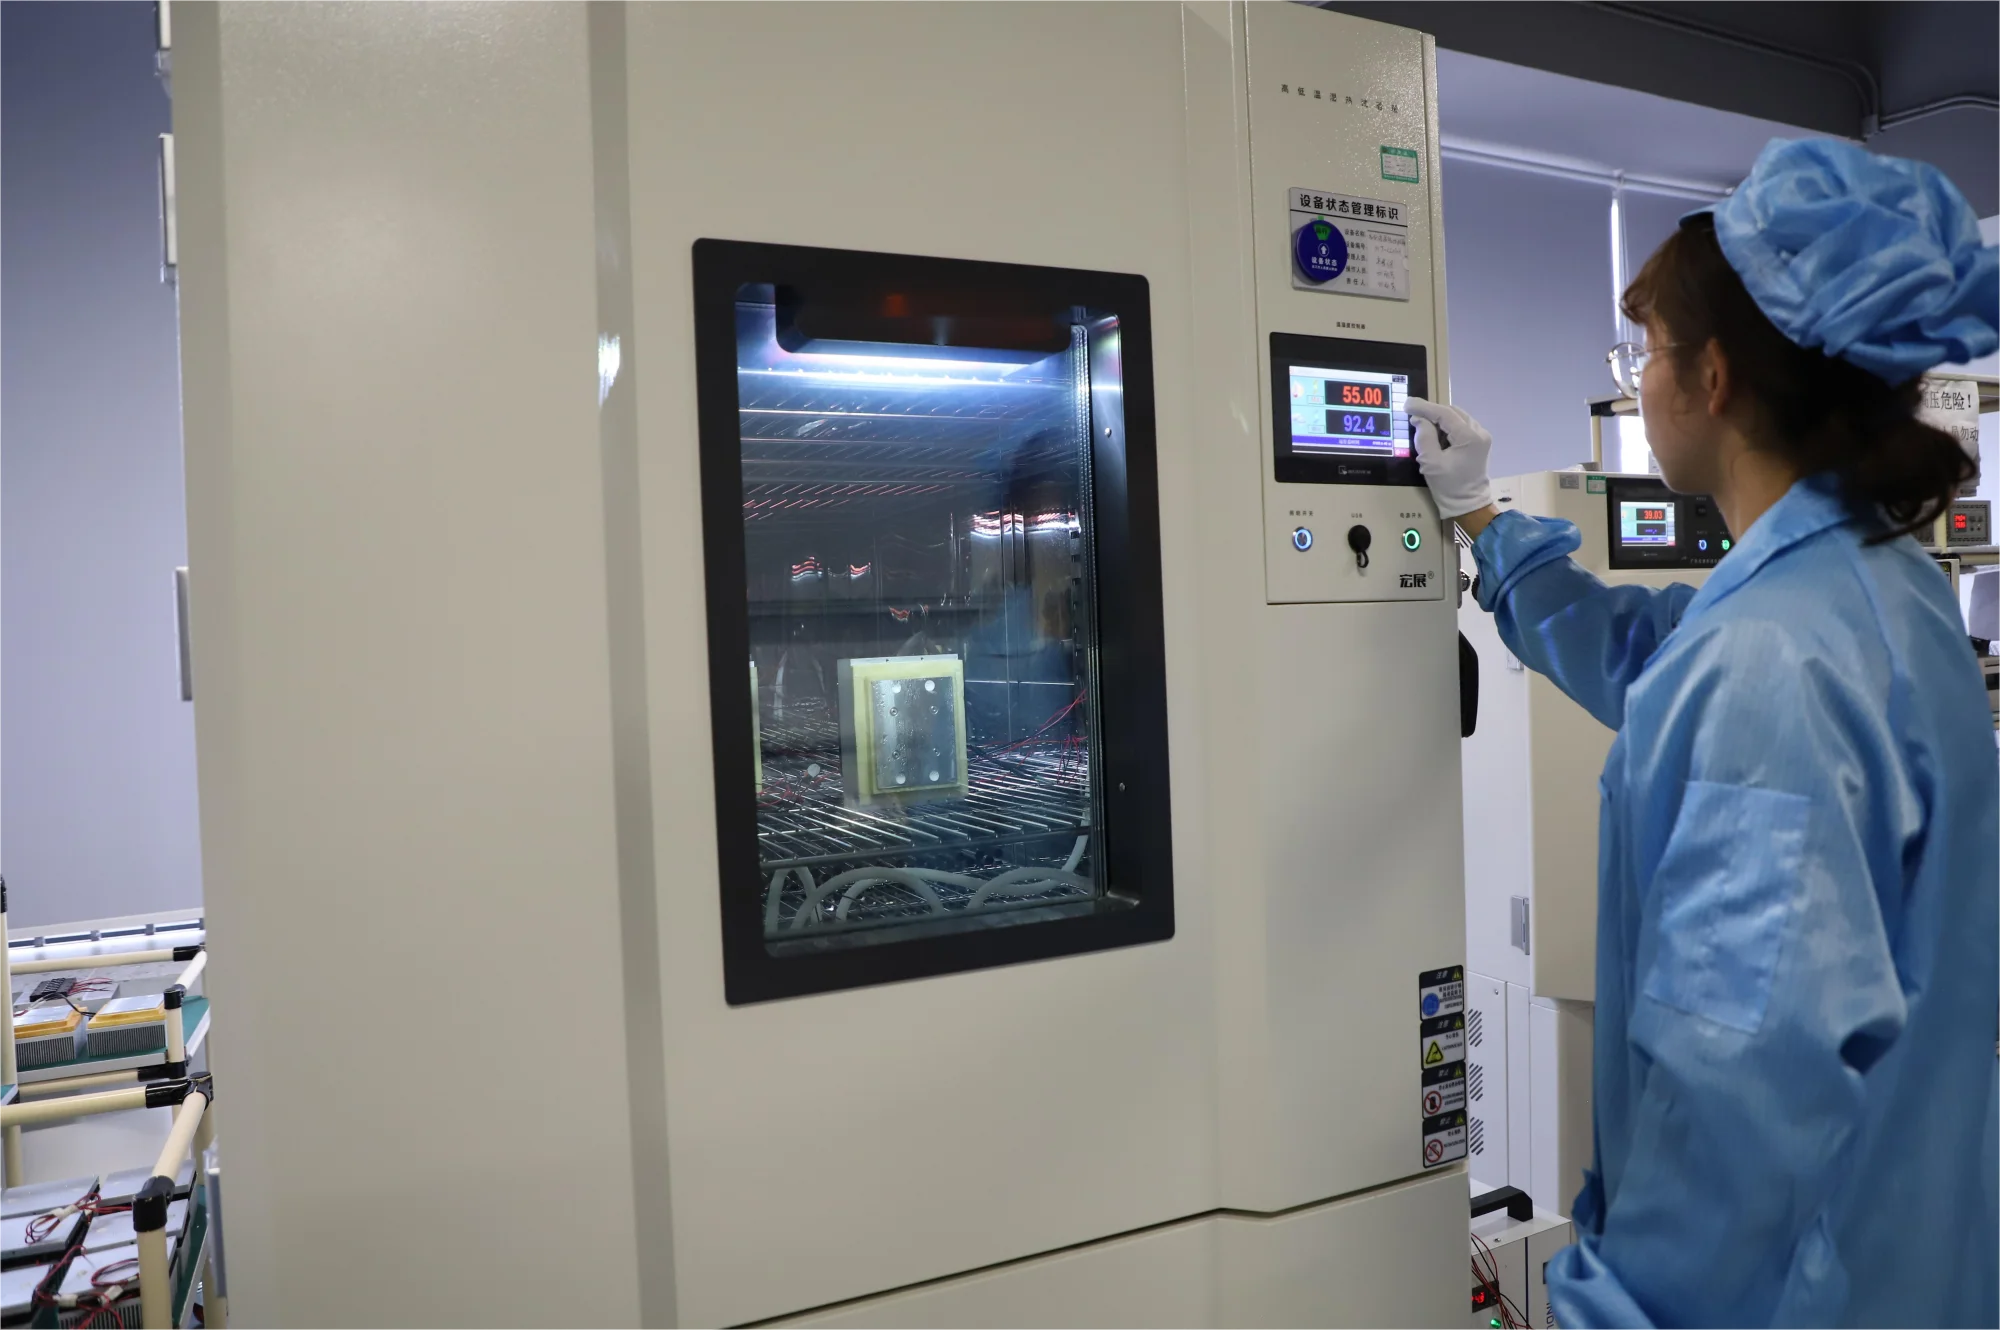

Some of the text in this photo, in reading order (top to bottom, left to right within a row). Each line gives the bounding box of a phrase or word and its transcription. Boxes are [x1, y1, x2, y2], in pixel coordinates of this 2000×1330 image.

[1300, 194, 1399, 220] 设备状态管理标识
[1311, 256, 1337, 267] 设备状态
[1342, 385, 1382, 405] 55.00
[1343, 414, 1375, 433] 92.4
